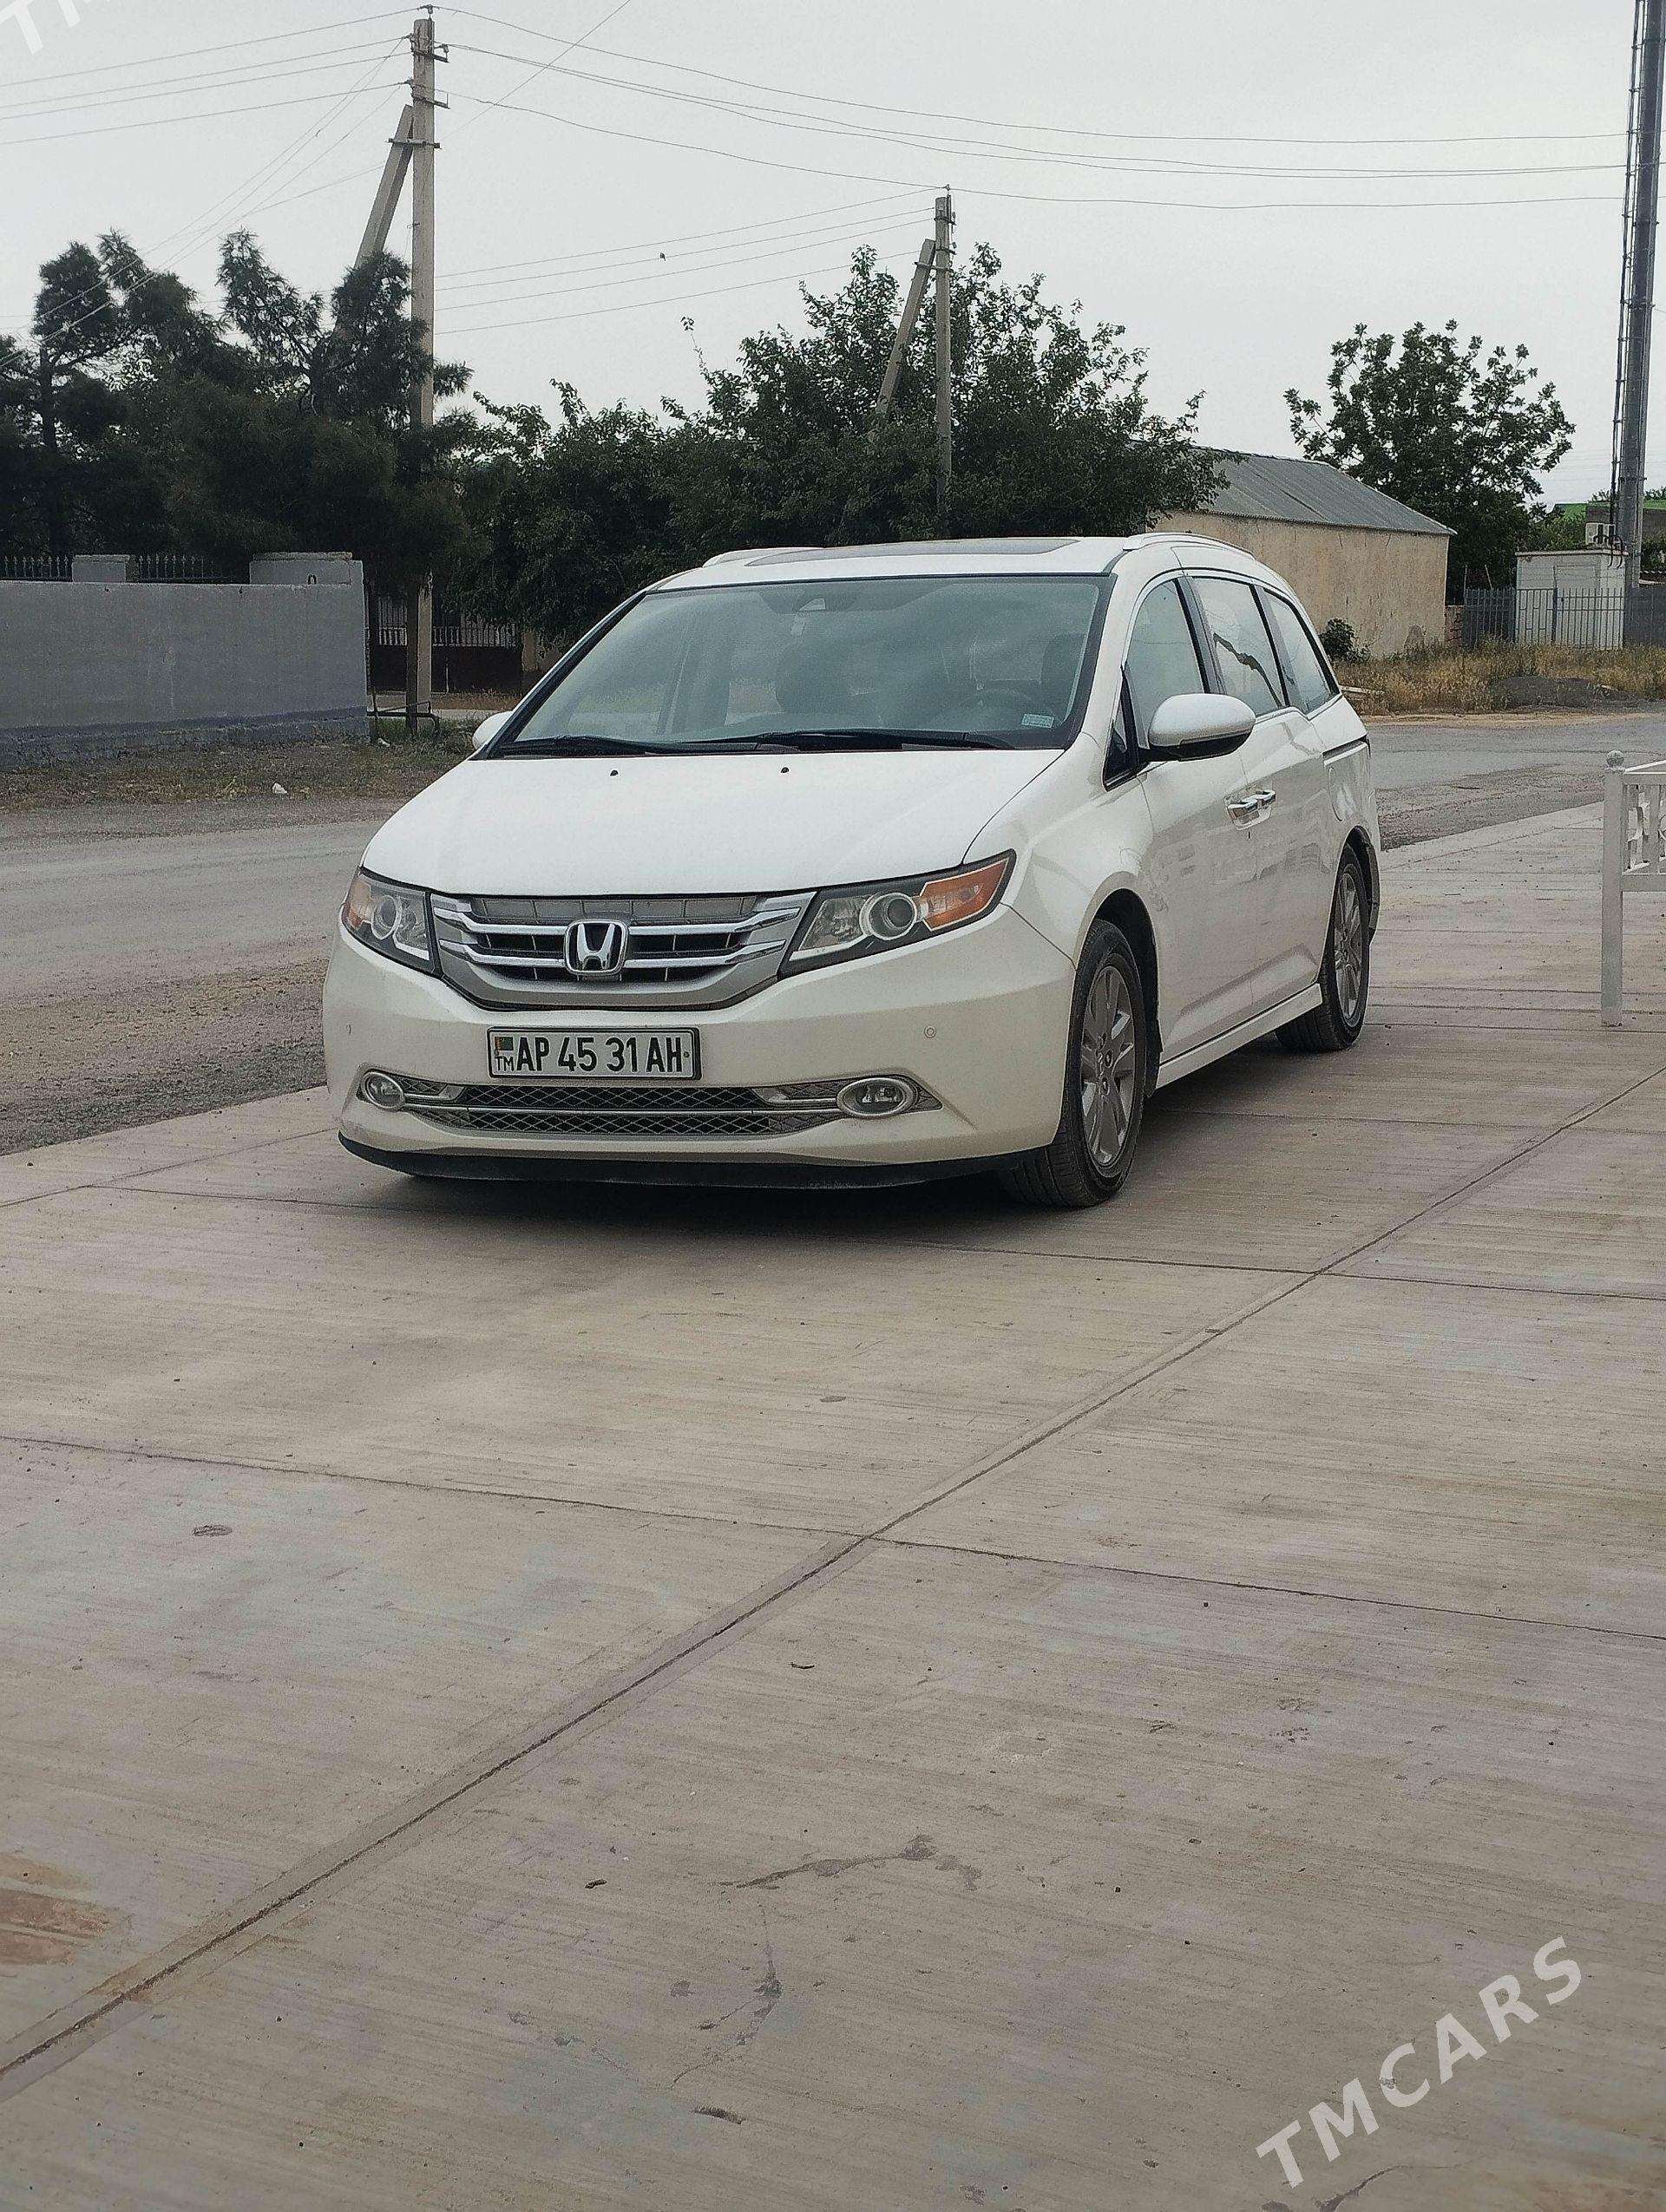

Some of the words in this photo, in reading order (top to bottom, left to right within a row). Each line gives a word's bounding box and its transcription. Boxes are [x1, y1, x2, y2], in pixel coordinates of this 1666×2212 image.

[494, 1056, 515, 1072] TM
[516, 1037, 549, 1071] AP
[558, 1037, 598, 1071] 45
[605, 1037, 638, 1072] 31
[646, 1037, 682, 1072] AH
